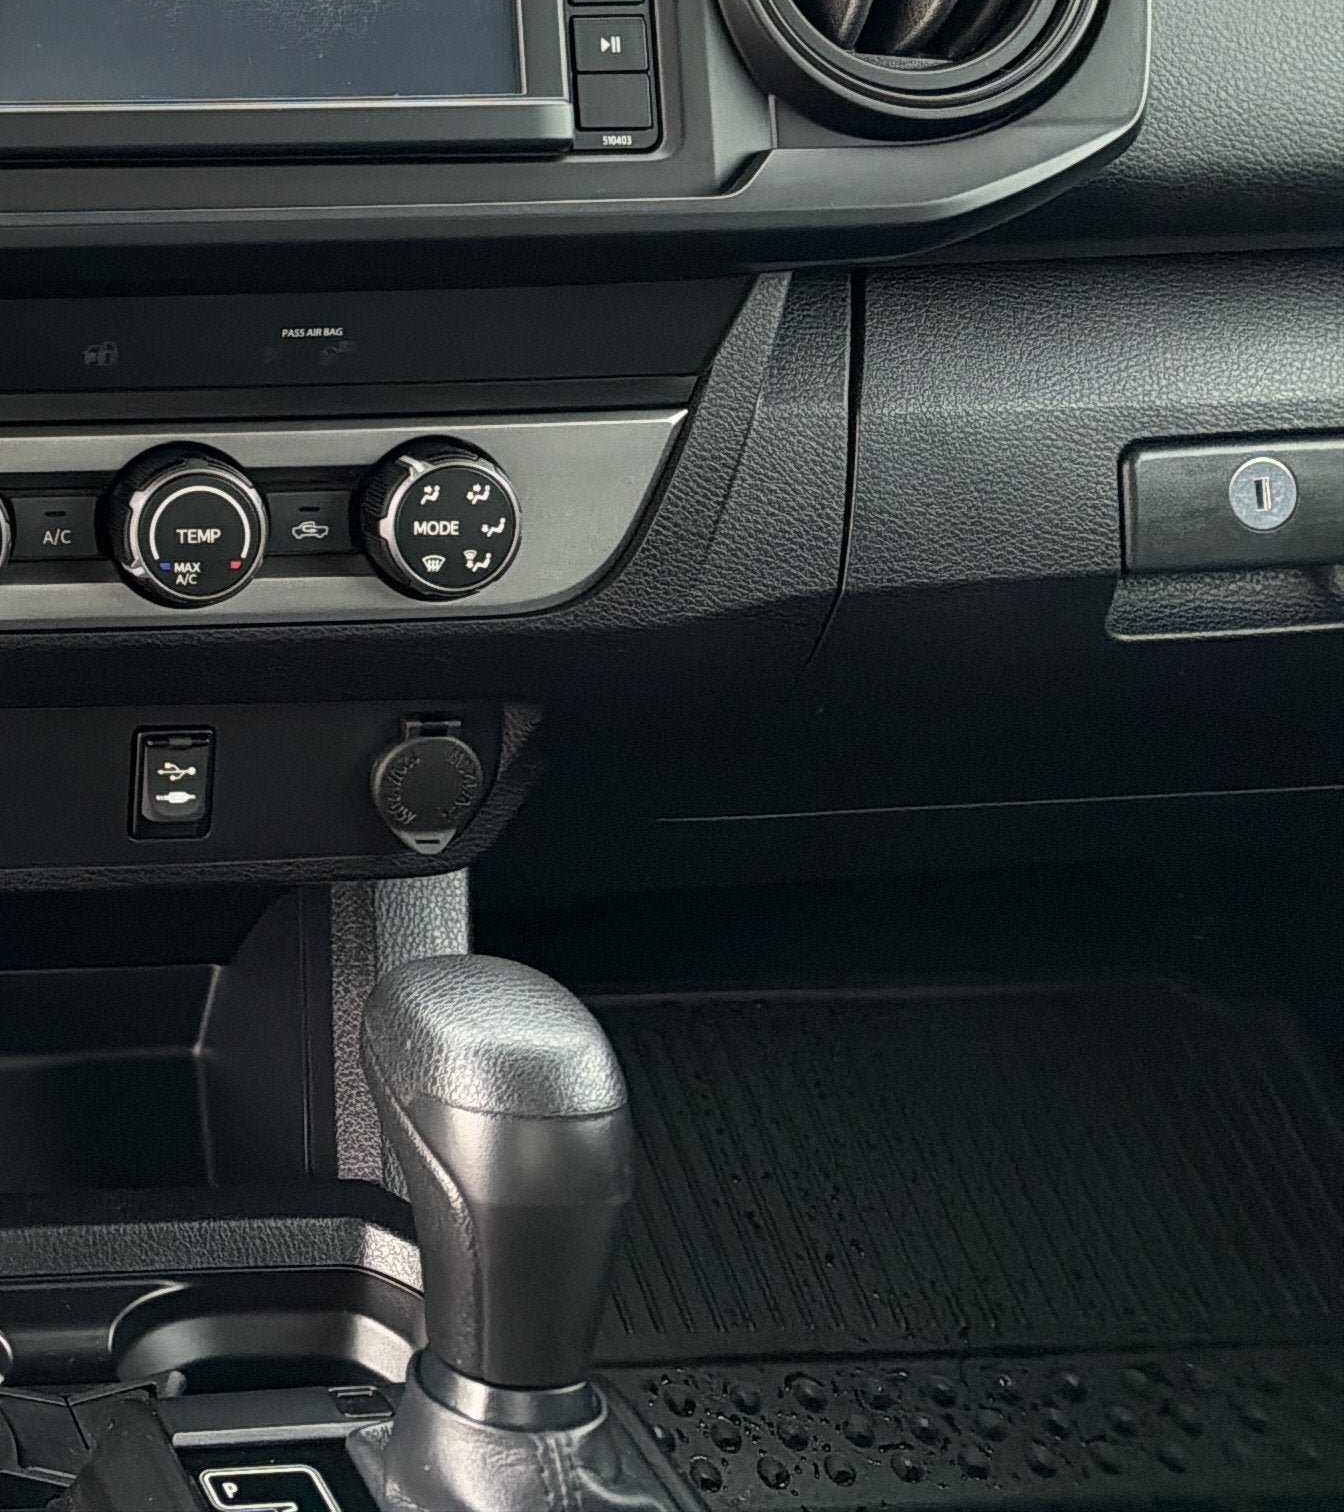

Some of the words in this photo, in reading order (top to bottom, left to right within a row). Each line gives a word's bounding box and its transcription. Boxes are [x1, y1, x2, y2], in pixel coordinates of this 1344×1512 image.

[602, 133, 633, 147] 510403
[281, 328, 305, 338] PASS
[306, 328, 322, 337] AIR
[323, 327, 344, 337] BAG
[175, 527, 221, 545] TEMP
[412, 520, 460, 537] MODE
[42, 528, 72, 547] A/C
[173, 561, 202, 574] MAX
[174, 572, 199, 586] A/C
[222, 1482, 238, 1499] P
